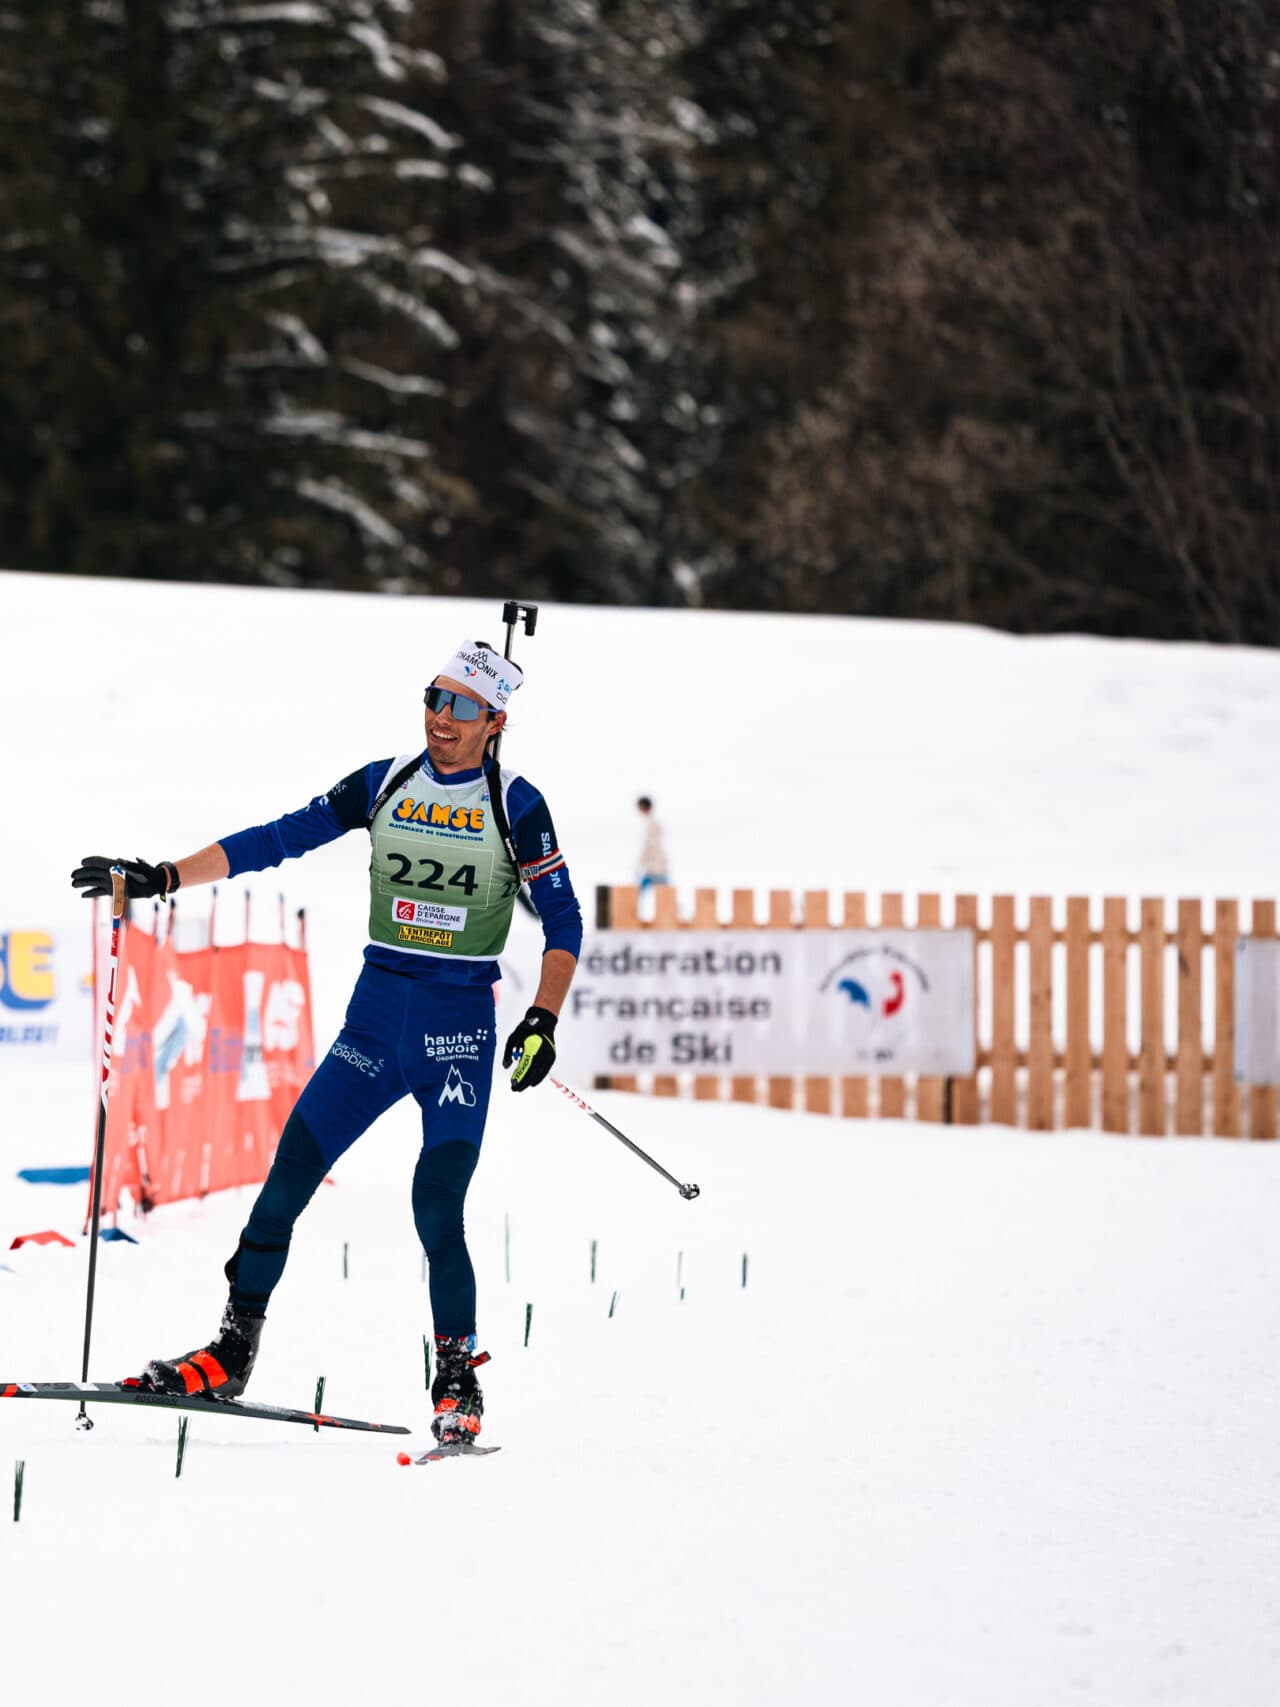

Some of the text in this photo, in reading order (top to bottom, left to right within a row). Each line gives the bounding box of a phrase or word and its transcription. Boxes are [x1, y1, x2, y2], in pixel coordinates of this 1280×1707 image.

[457, 651, 498, 680] CHAMONIX
[392, 797, 485, 834] SAMSE
[386, 852, 479, 896] 224
[417, 904, 446, 914] CAISSE
[417, 910, 461, 923] D'EPARGNE
[582, 945, 783, 977] édération
[572, 987, 772, 1022] Française
[424, 1032, 473, 1047] haute
[426, 1044, 479, 1057] savoie
[609, 1032, 734, 1065] de Ski
